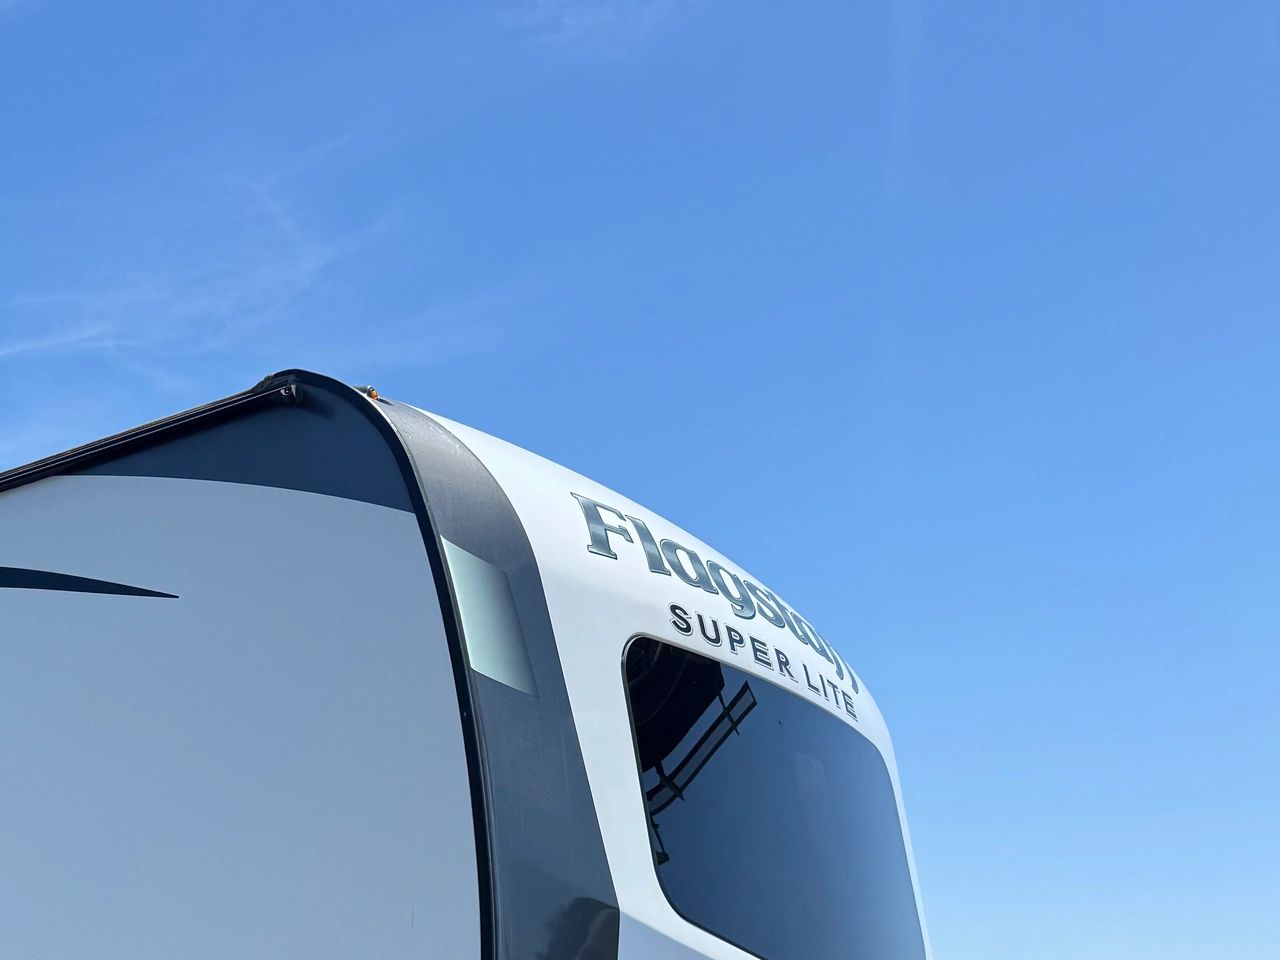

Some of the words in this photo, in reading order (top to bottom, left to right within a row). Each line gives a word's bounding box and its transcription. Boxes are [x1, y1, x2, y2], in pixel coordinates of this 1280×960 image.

[570, 491, 859, 695] Flagstaff
[668, 602, 798, 683] SUPER
[802, 662, 859, 722] LITE
